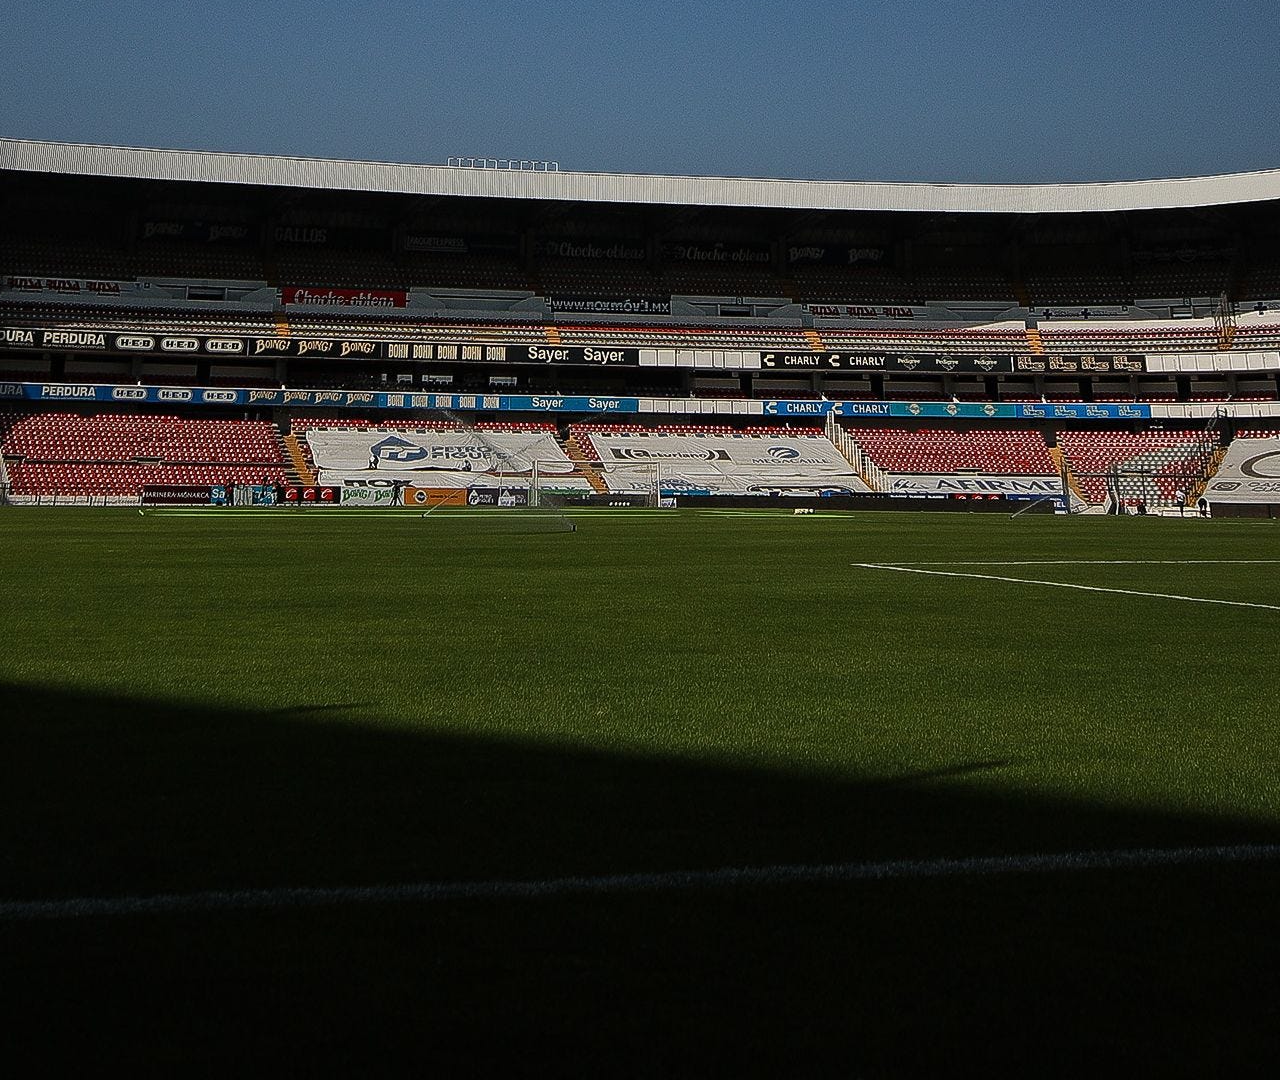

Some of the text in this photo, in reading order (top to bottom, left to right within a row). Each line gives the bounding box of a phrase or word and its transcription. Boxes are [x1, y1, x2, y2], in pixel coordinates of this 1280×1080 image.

[43, 332, 106, 346] PERDURA
[784, 356, 821, 366] CHARLY
[849, 356, 885, 366] CHARLY
[41, 386, 96, 398] PERDURA
[786, 403, 823, 413] CHARLY
[852, 404, 889, 414] CHARLY
[936, 478, 1062, 492] AFIRME
